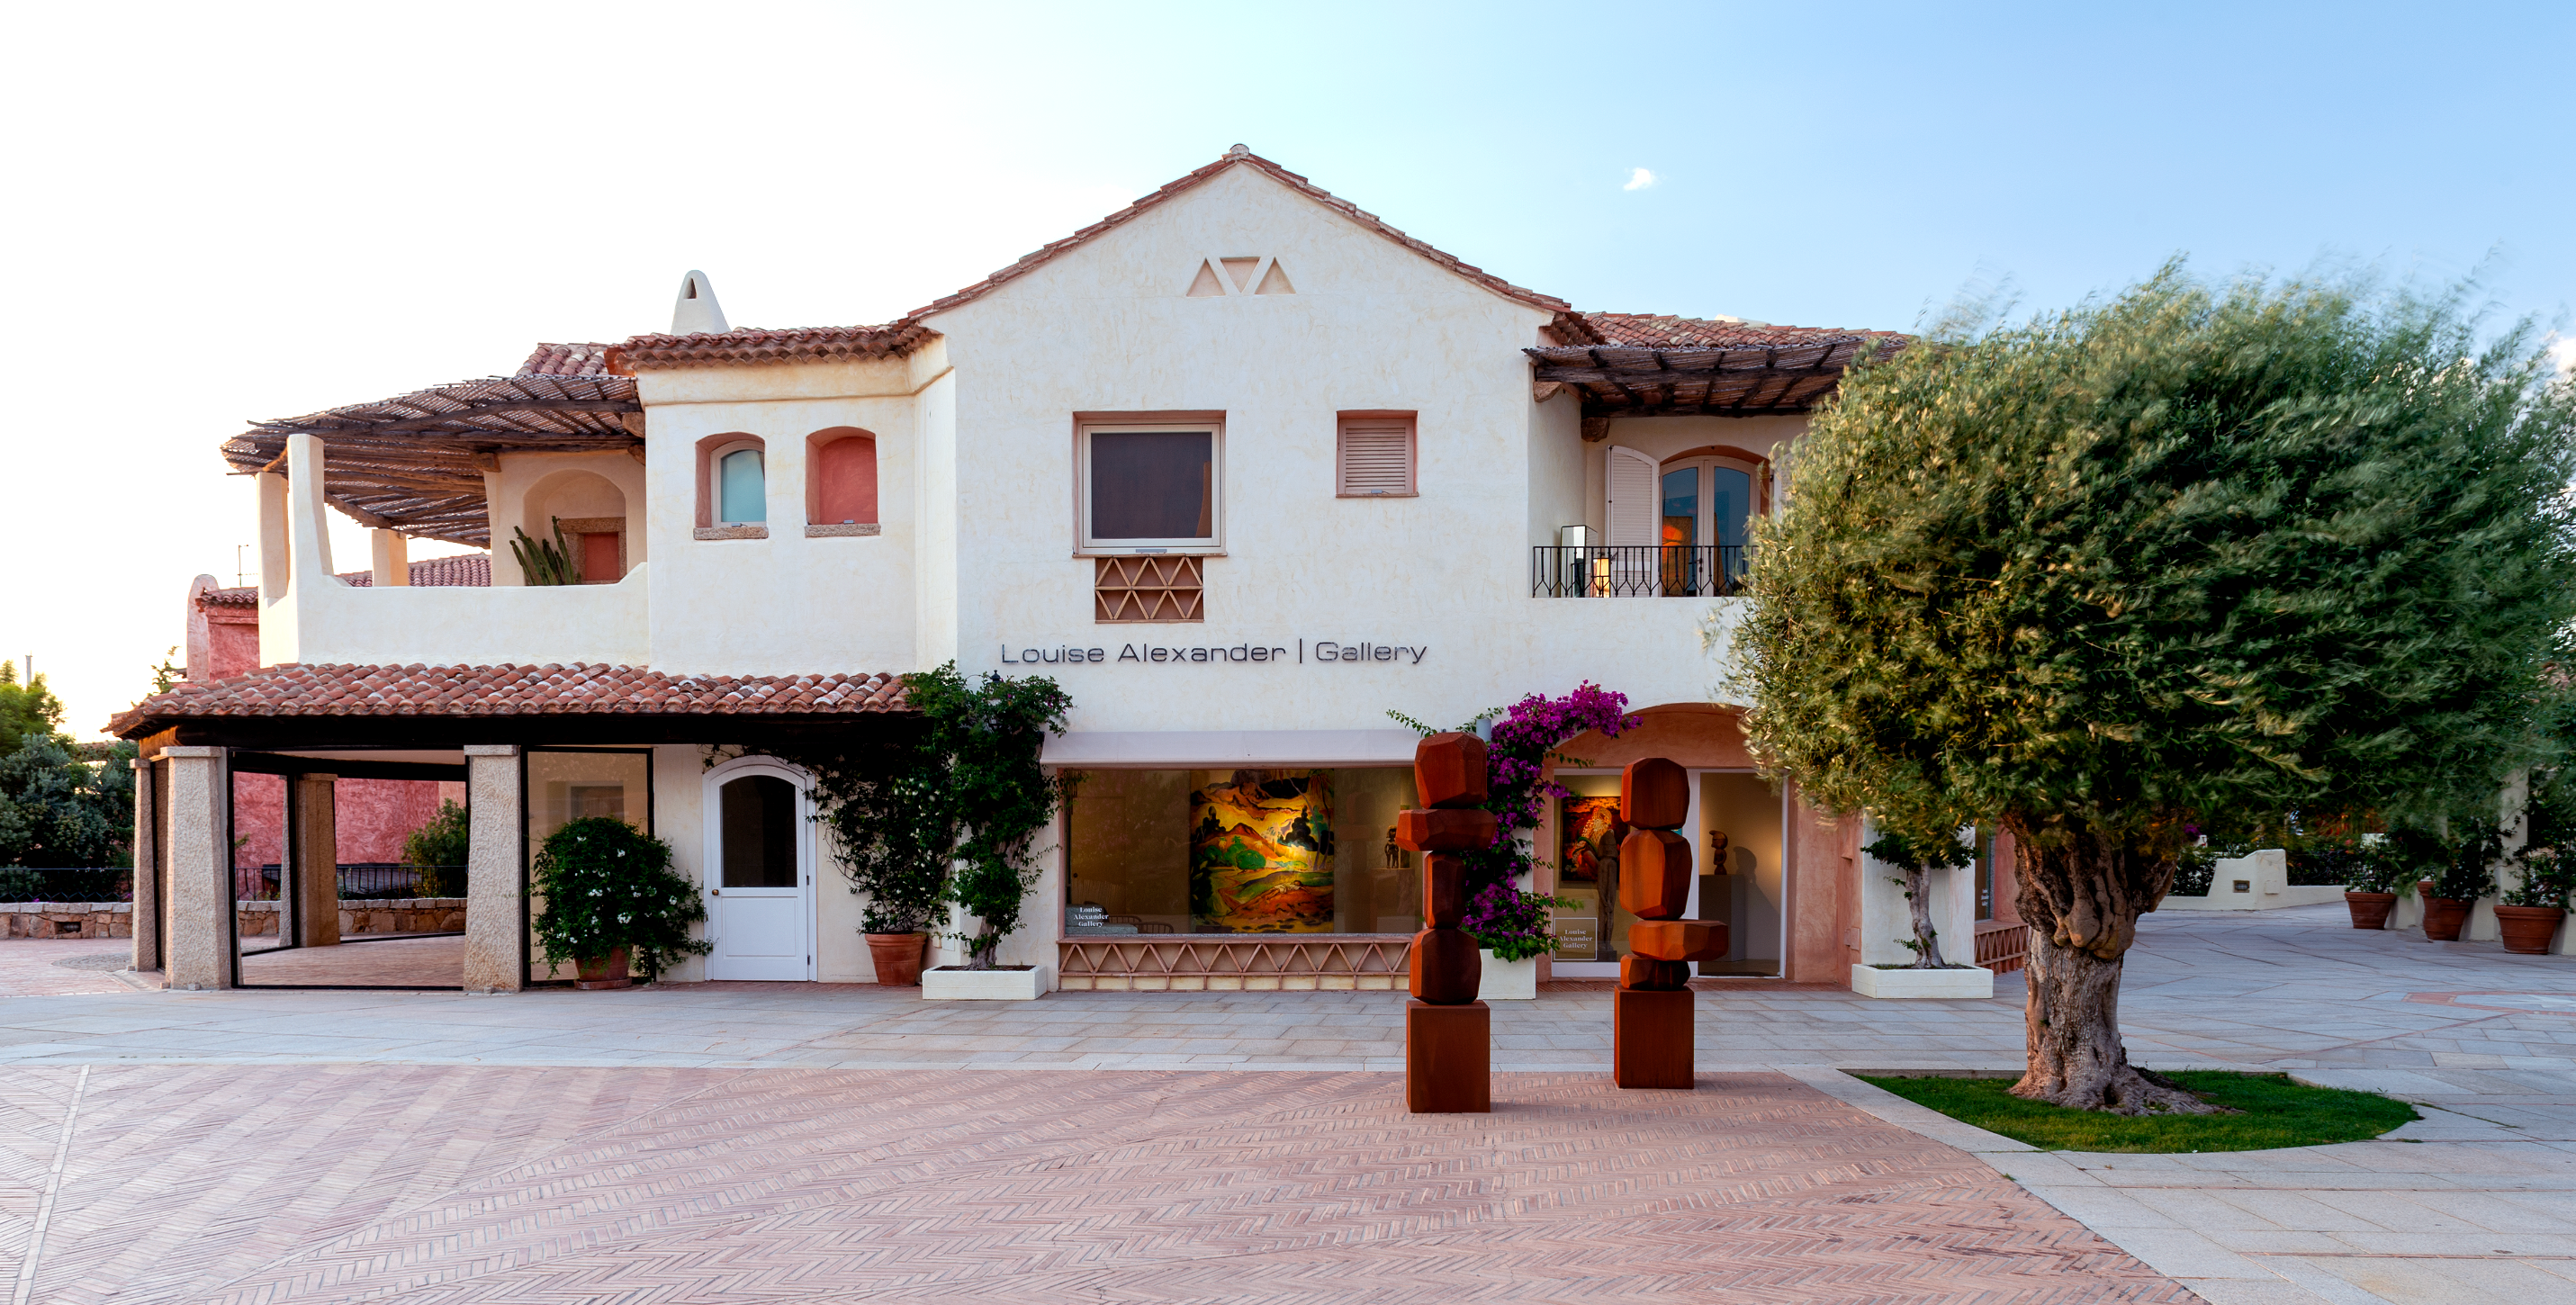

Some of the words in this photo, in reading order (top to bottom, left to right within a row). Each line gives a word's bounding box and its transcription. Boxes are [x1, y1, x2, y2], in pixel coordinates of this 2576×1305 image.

[1002, 644, 1104, 663] Louise
[1117, 643, 1286, 662] Alexander
[1315, 642, 1428, 665] Gallery
